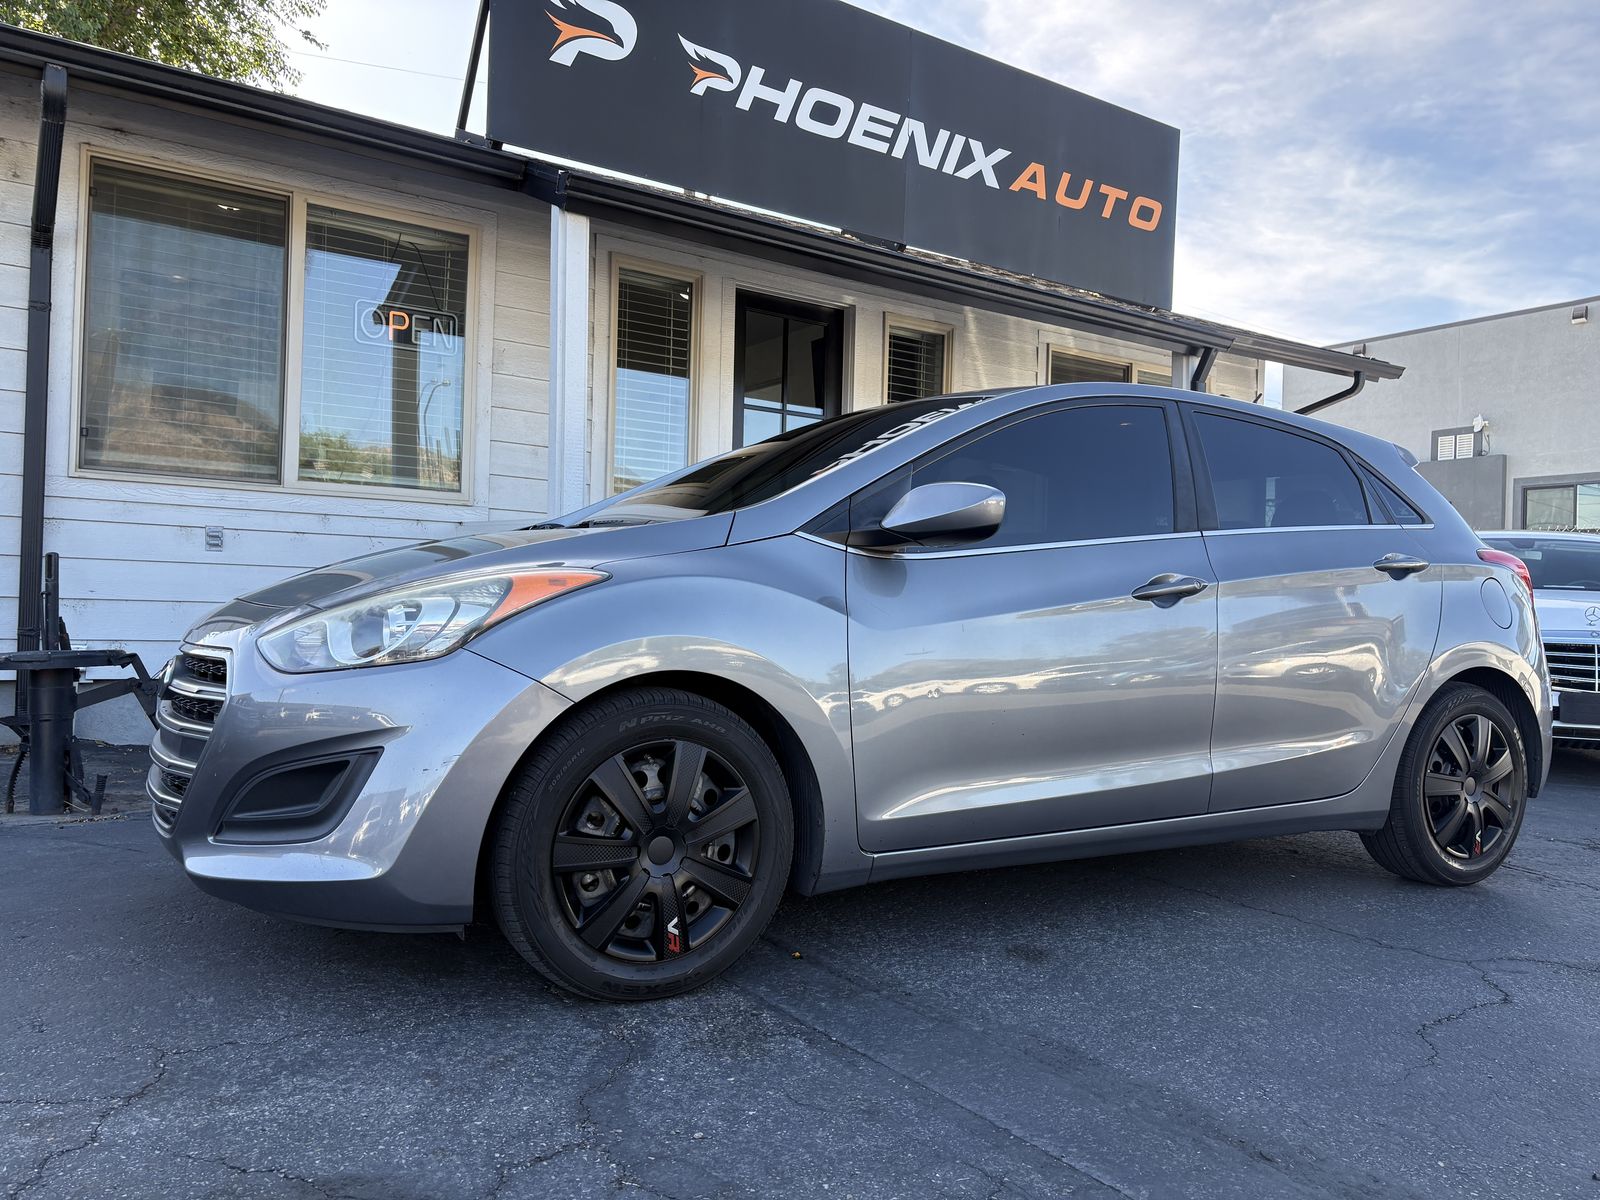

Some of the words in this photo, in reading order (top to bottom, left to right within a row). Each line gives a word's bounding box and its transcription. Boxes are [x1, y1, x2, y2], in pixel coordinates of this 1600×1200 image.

[677, 33, 1012, 189] PHOENIX
[1009, 162, 1164, 232] AUTO
[360, 307, 454, 349] OPEN
